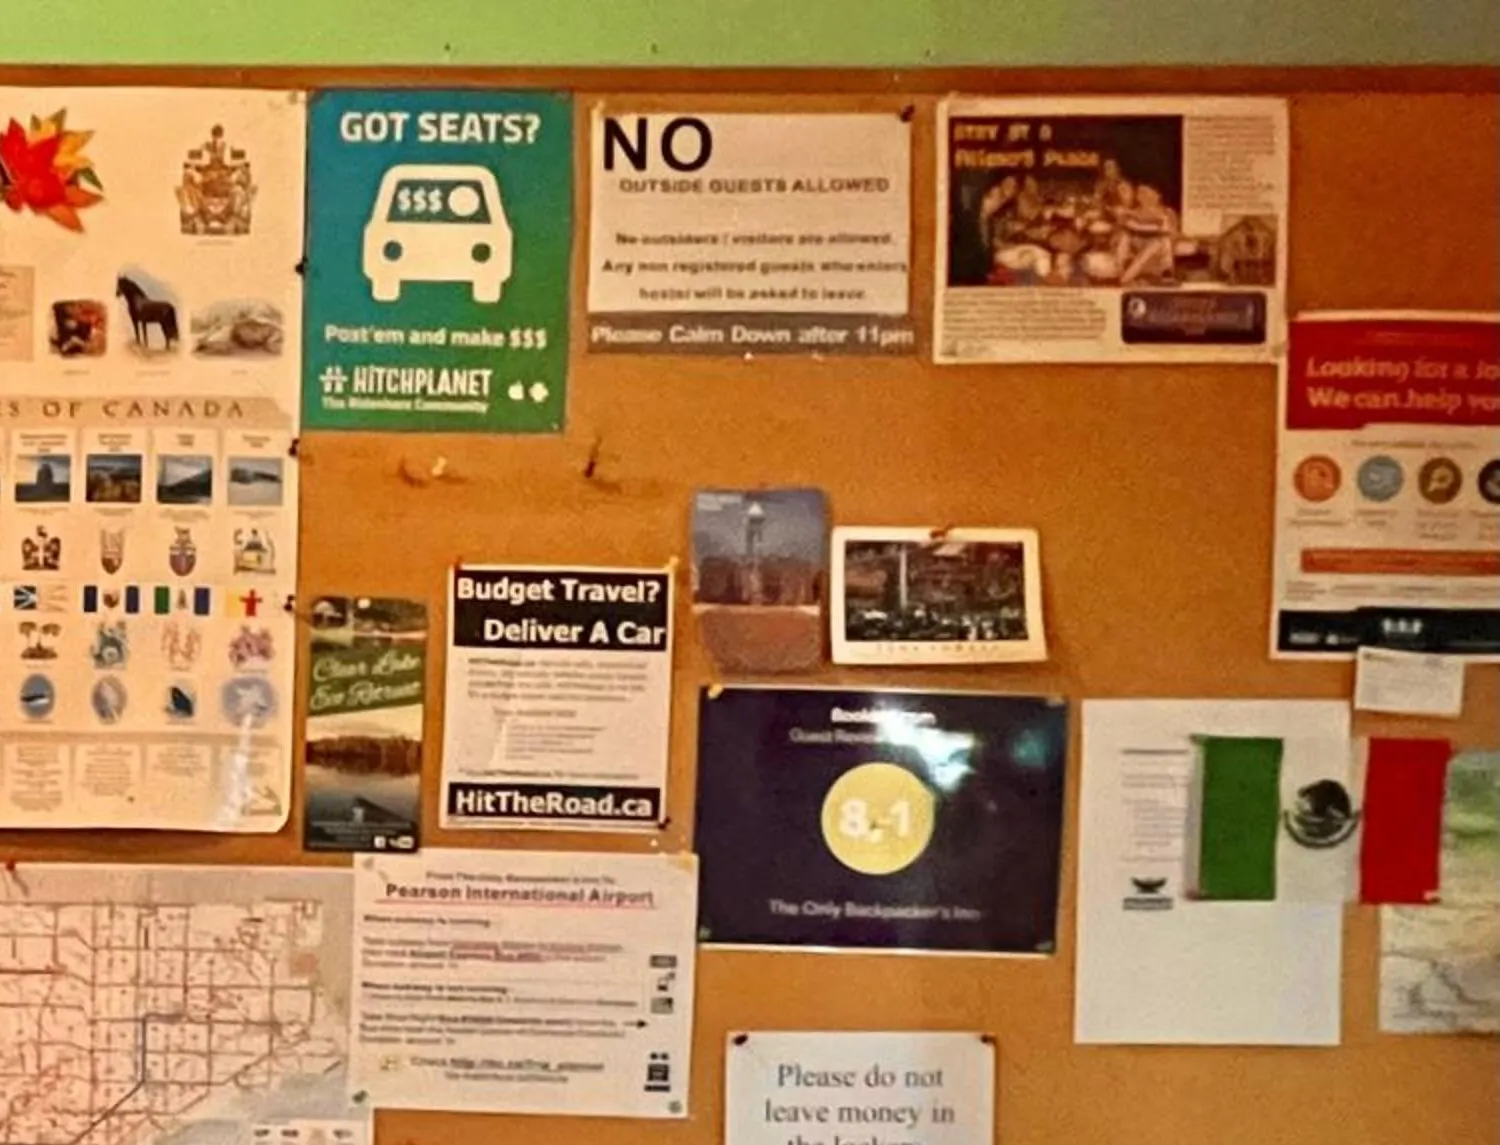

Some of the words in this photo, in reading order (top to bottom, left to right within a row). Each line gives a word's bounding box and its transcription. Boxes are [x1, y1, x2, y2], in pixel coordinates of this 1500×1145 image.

[340, 111, 410, 141] GOT
[418, 113, 541, 143] SEATS?
[604, 117, 712, 172] NO
[620, 178, 702, 193] OUTSIDE
[709, 178, 787, 193] GUESTS
[792, 178, 889, 193] ALLOWED
[602, 259, 633, 276] Any
[409, 329, 446, 345] and
[451, 329, 504, 346] make
[509, 328, 547, 349] $$$
[592, 326, 662, 343] Please
[669, 326, 723, 343] Calm
[731, 326, 790, 343] Down
[798, 326, 847, 343] after
[857, 326, 914, 346] 11pm
[1306, 356, 1409, 383] Looking
[1414, 356, 1449, 379] for
[1454, 363, 1469, 379] a
[42, 401, 82, 418] OF
[103, 400, 245, 419] CANADA
[1306, 386, 1350, 409] We
[1354, 391, 1400, 409] can
[1404, 387, 1462, 415] help
[456, 577, 554, 605] Budget
[560, 578, 661, 603] Travel?
[483, 619, 583, 644] Deliver
[588, 622, 612, 644] A
[616, 621, 666, 645] Car
[455, 789, 653, 818] HitTheRoad.ca
[386, 883, 461, 898] Pearson
[466, 885, 584, 902] International
[589, 888, 654, 908] Airport
[769, 899, 798, 915] The
[802, 900, 841, 919] Only
[777, 1063, 856, 1089] Please
[865, 1064, 896, 1088] do
[905, 1065, 944, 1089] not
[764, 1099, 830, 1124] leave
[838, 1102, 920, 1130] money
[931, 1101, 956, 1125] in
